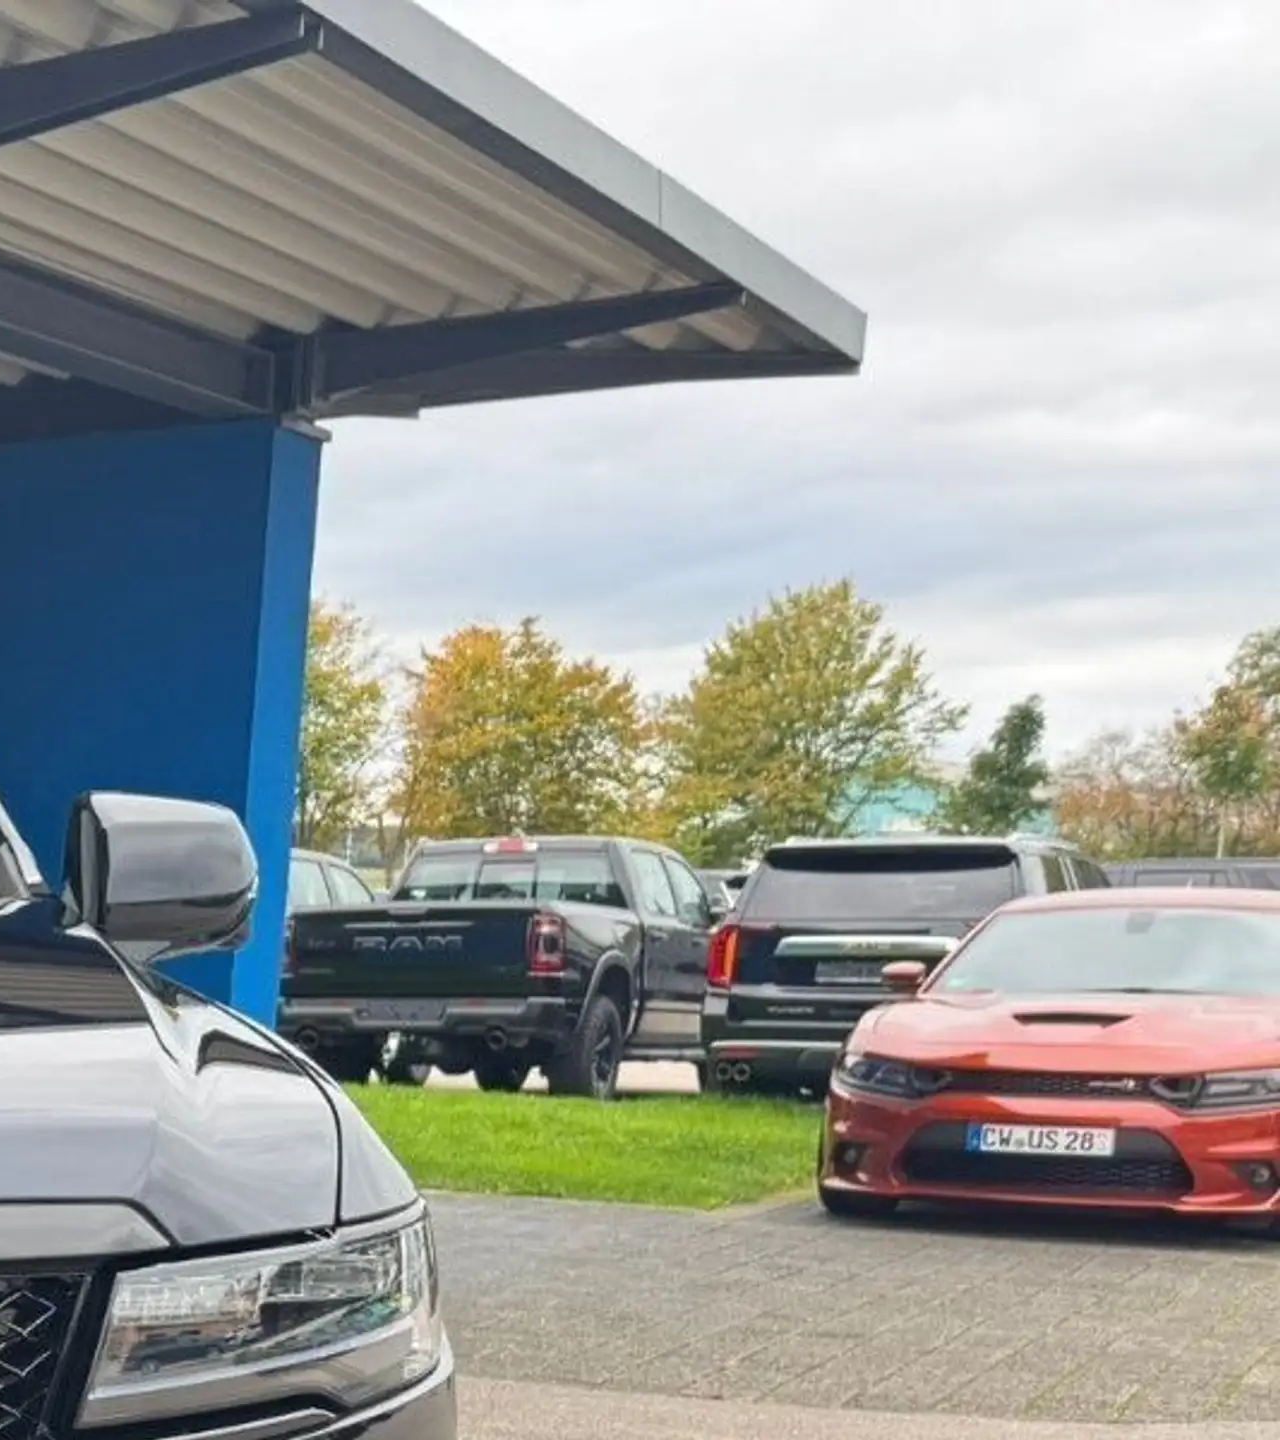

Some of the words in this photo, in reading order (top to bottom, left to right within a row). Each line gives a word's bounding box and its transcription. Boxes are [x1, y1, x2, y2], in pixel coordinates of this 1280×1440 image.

[352, 935, 464, 956] RAM
[982, 1127, 1013, 1150] CW
[1027, 1129, 1059, 1151] US
